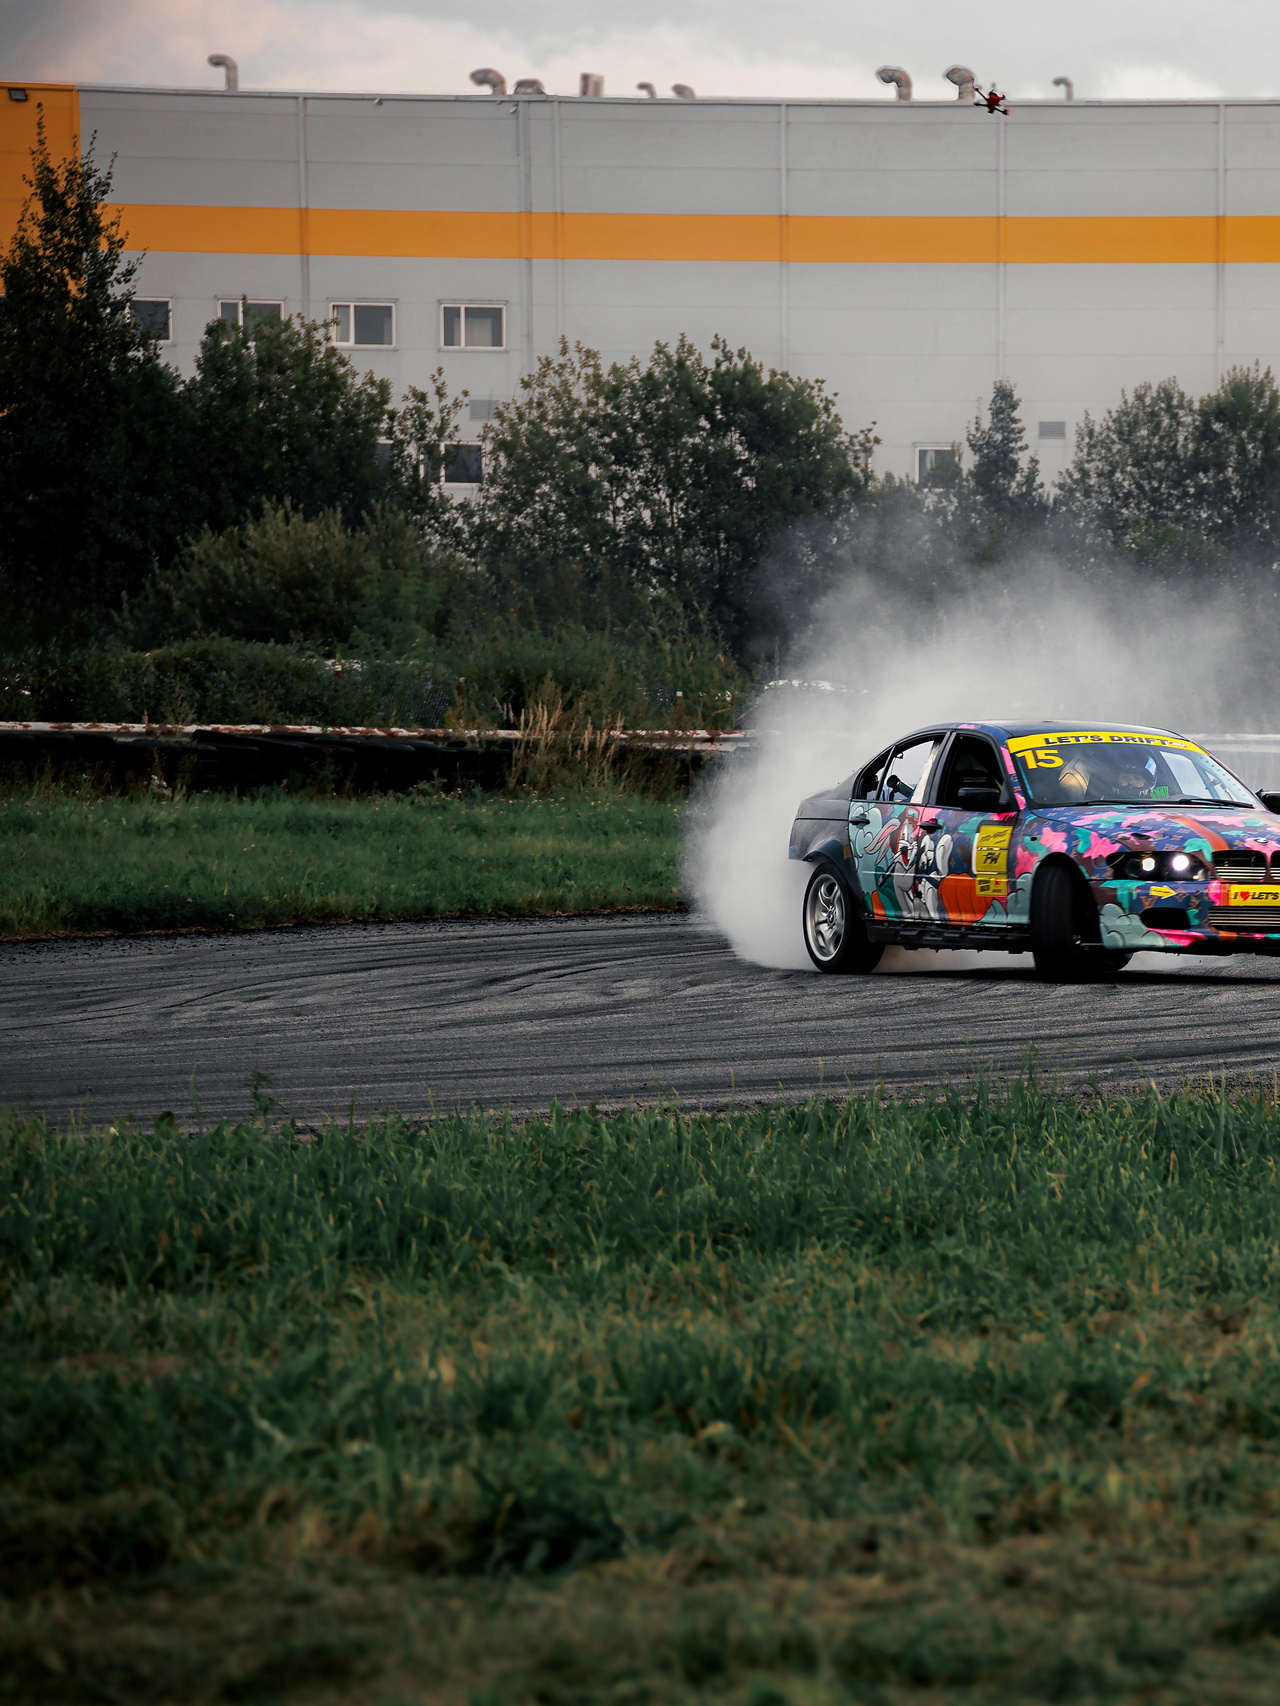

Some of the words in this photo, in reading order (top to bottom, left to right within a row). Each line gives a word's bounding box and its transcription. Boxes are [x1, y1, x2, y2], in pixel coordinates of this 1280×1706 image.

[1044, 735, 1104, 745] LET'S
[1109, 736, 1168, 746] DRIFT
[1015, 750, 1064, 770] 15
[1233, 892, 1239, 900] I
[1251, 892, 1279, 900] LET'S
